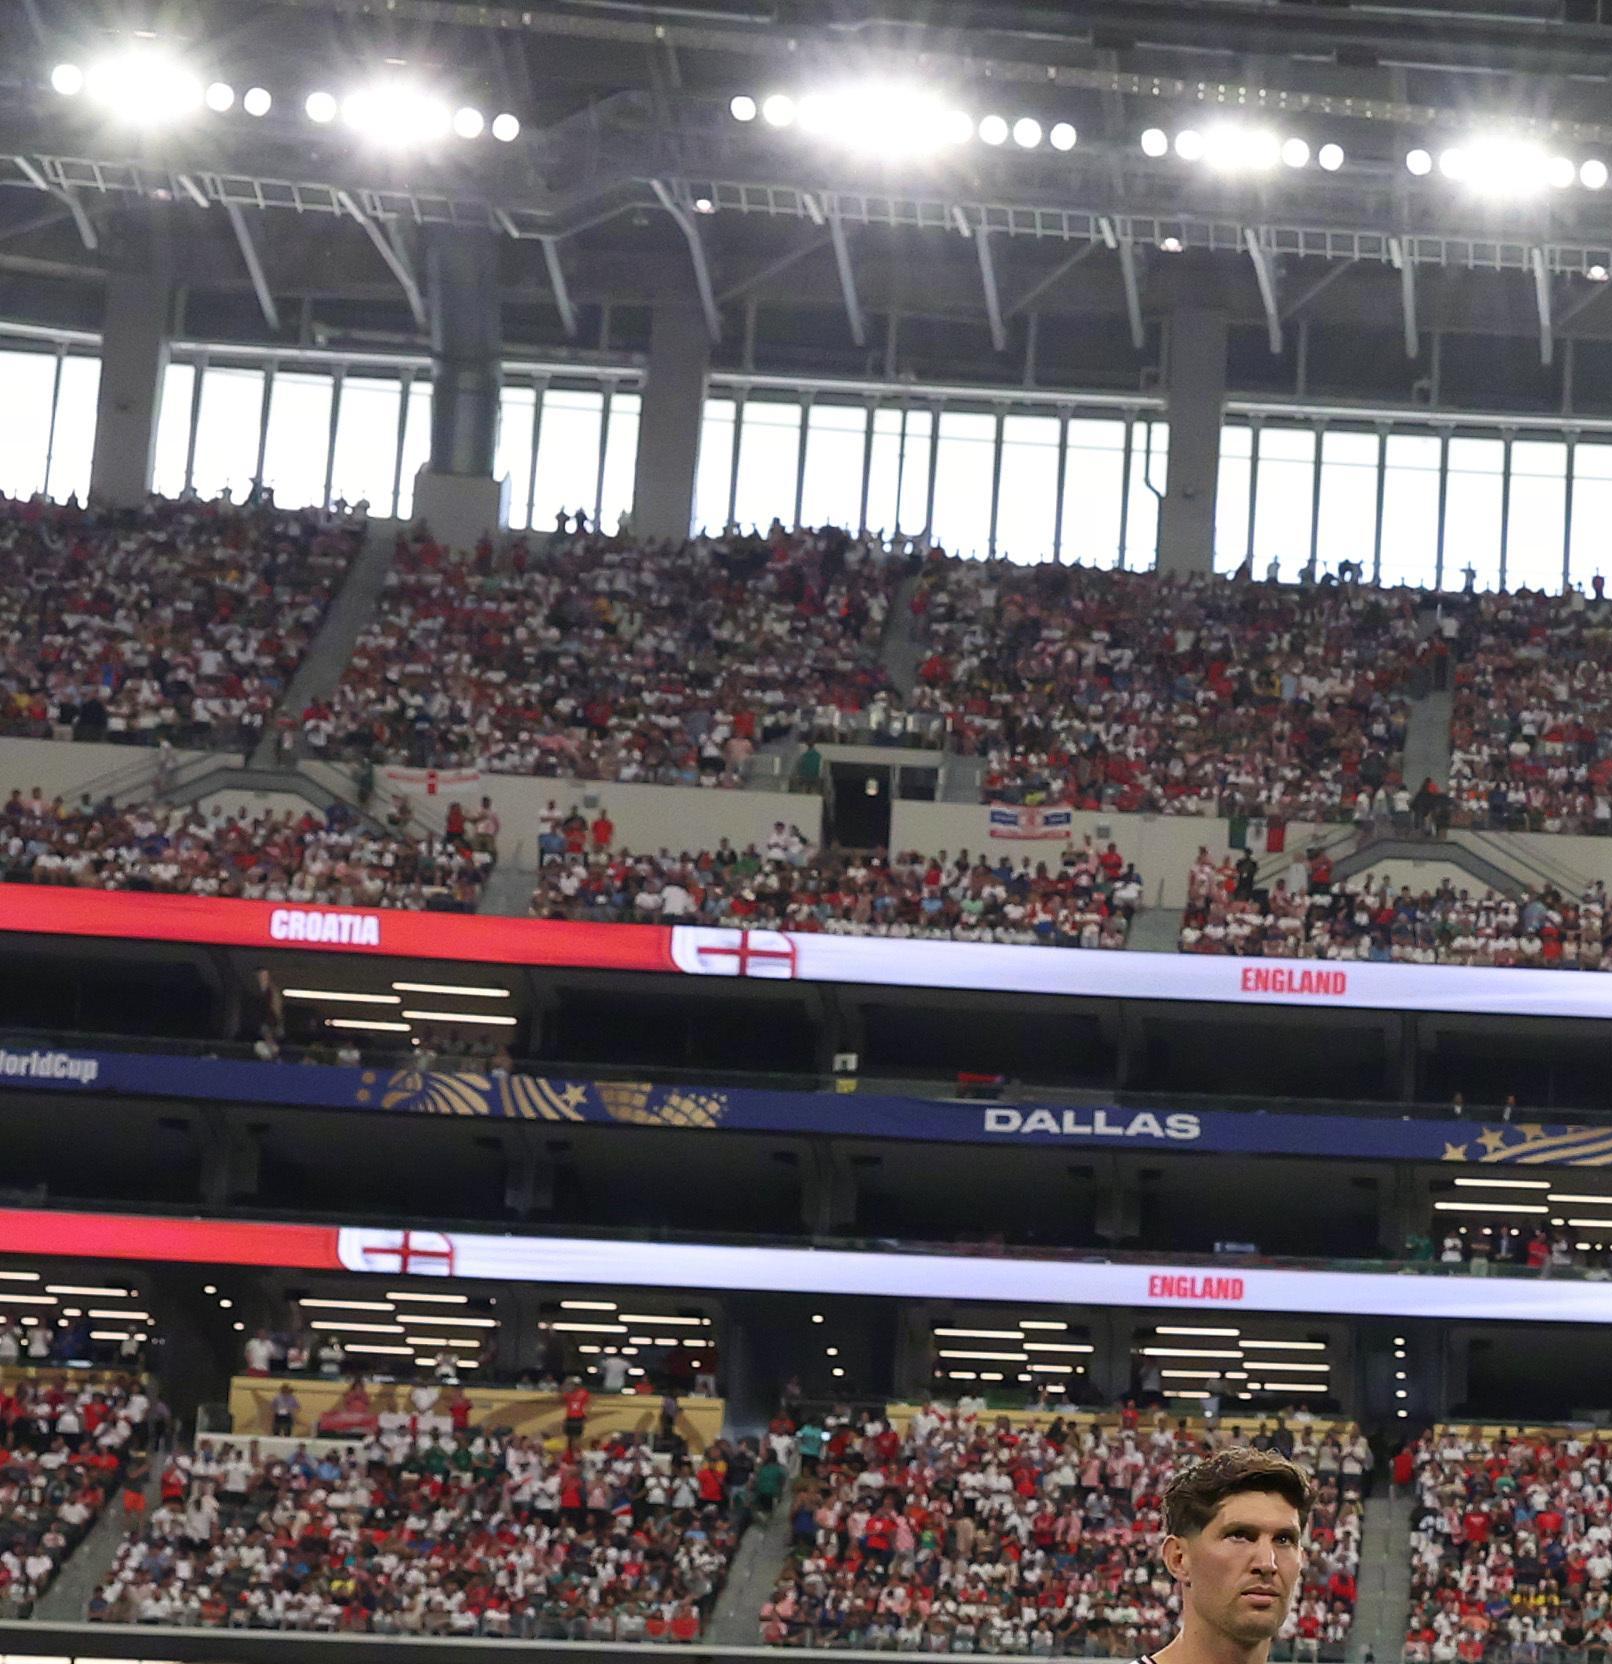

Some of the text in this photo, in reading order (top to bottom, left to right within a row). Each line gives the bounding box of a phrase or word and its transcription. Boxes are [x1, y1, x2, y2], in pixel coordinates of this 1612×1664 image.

[270, 909, 380, 945] CROATIA
[1241, 967, 1347, 996] ENGLAND
[0, 1051, 98, 1084] orldCup
[984, 1108, 1201, 1140] DALLAS
[1148, 1275, 1245, 1301] ENGLAND
